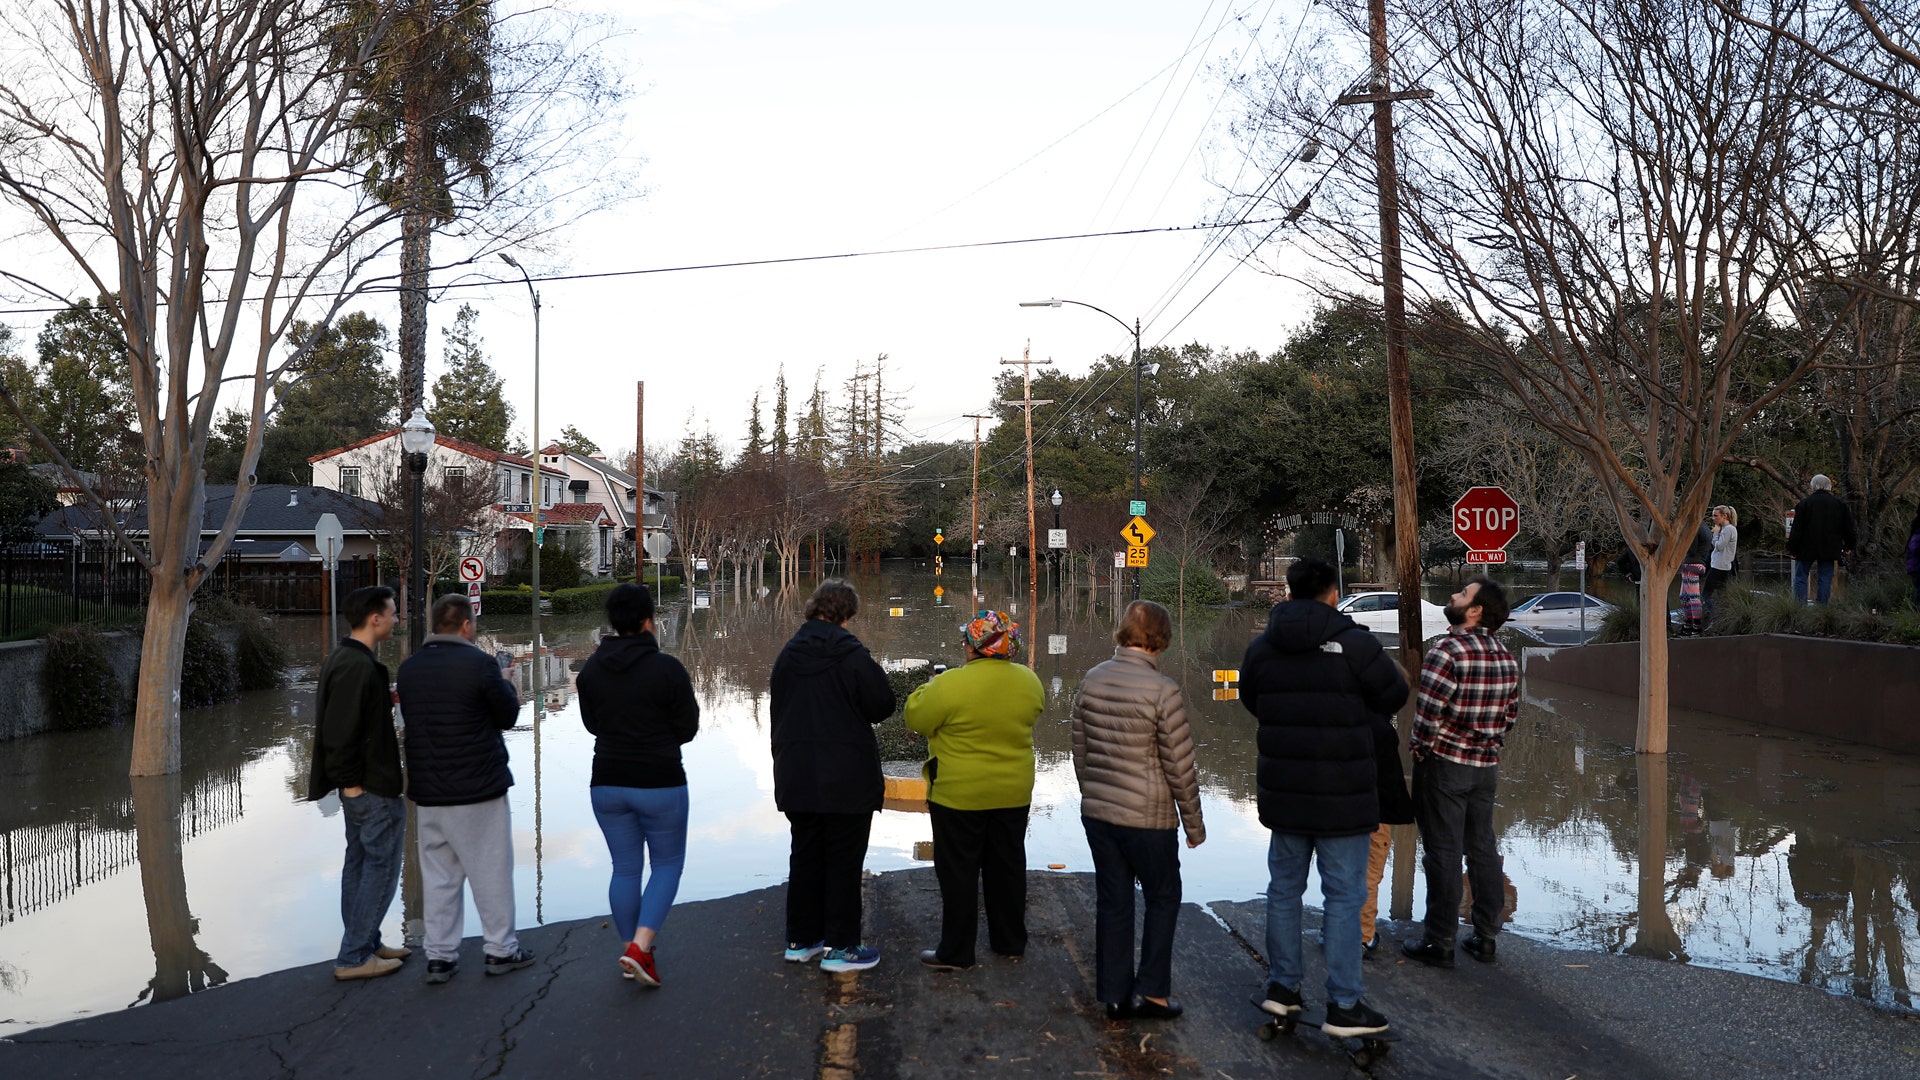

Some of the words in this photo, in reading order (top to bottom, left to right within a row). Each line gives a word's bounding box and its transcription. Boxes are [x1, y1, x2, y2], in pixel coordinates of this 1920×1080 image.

[1311, 512, 1332, 524] STREET
[1457, 508, 1515, 530] STOP
[1130, 548, 1146, 558] 25
